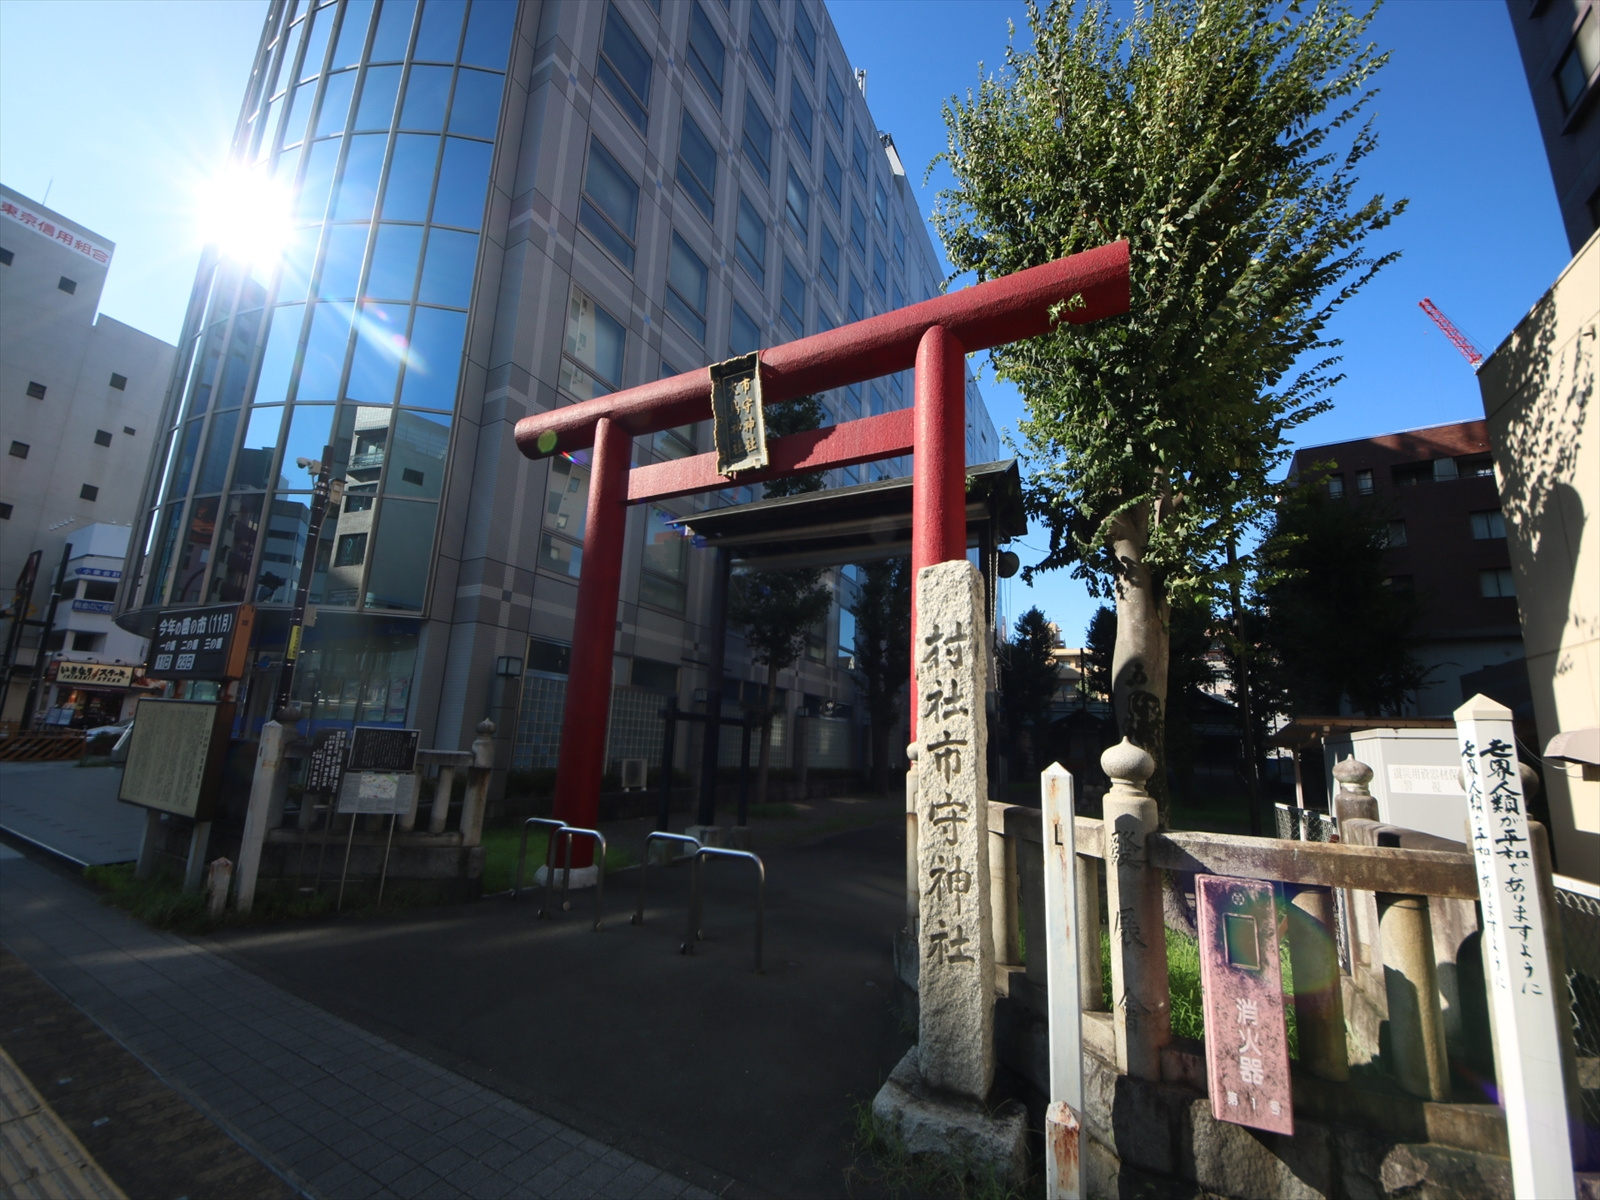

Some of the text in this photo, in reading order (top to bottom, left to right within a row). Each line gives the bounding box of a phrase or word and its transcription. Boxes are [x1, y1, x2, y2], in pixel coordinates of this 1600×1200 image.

[741, 377, 758, 453] 市守神社
[157, 655, 193, 669] 11日 23日
[921, 621, 976, 966] 村社市守神社
[1479, 738, 1543, 996] 世界人類が平和でありますように
[1236, 997, 1264, 1087] 消火器
